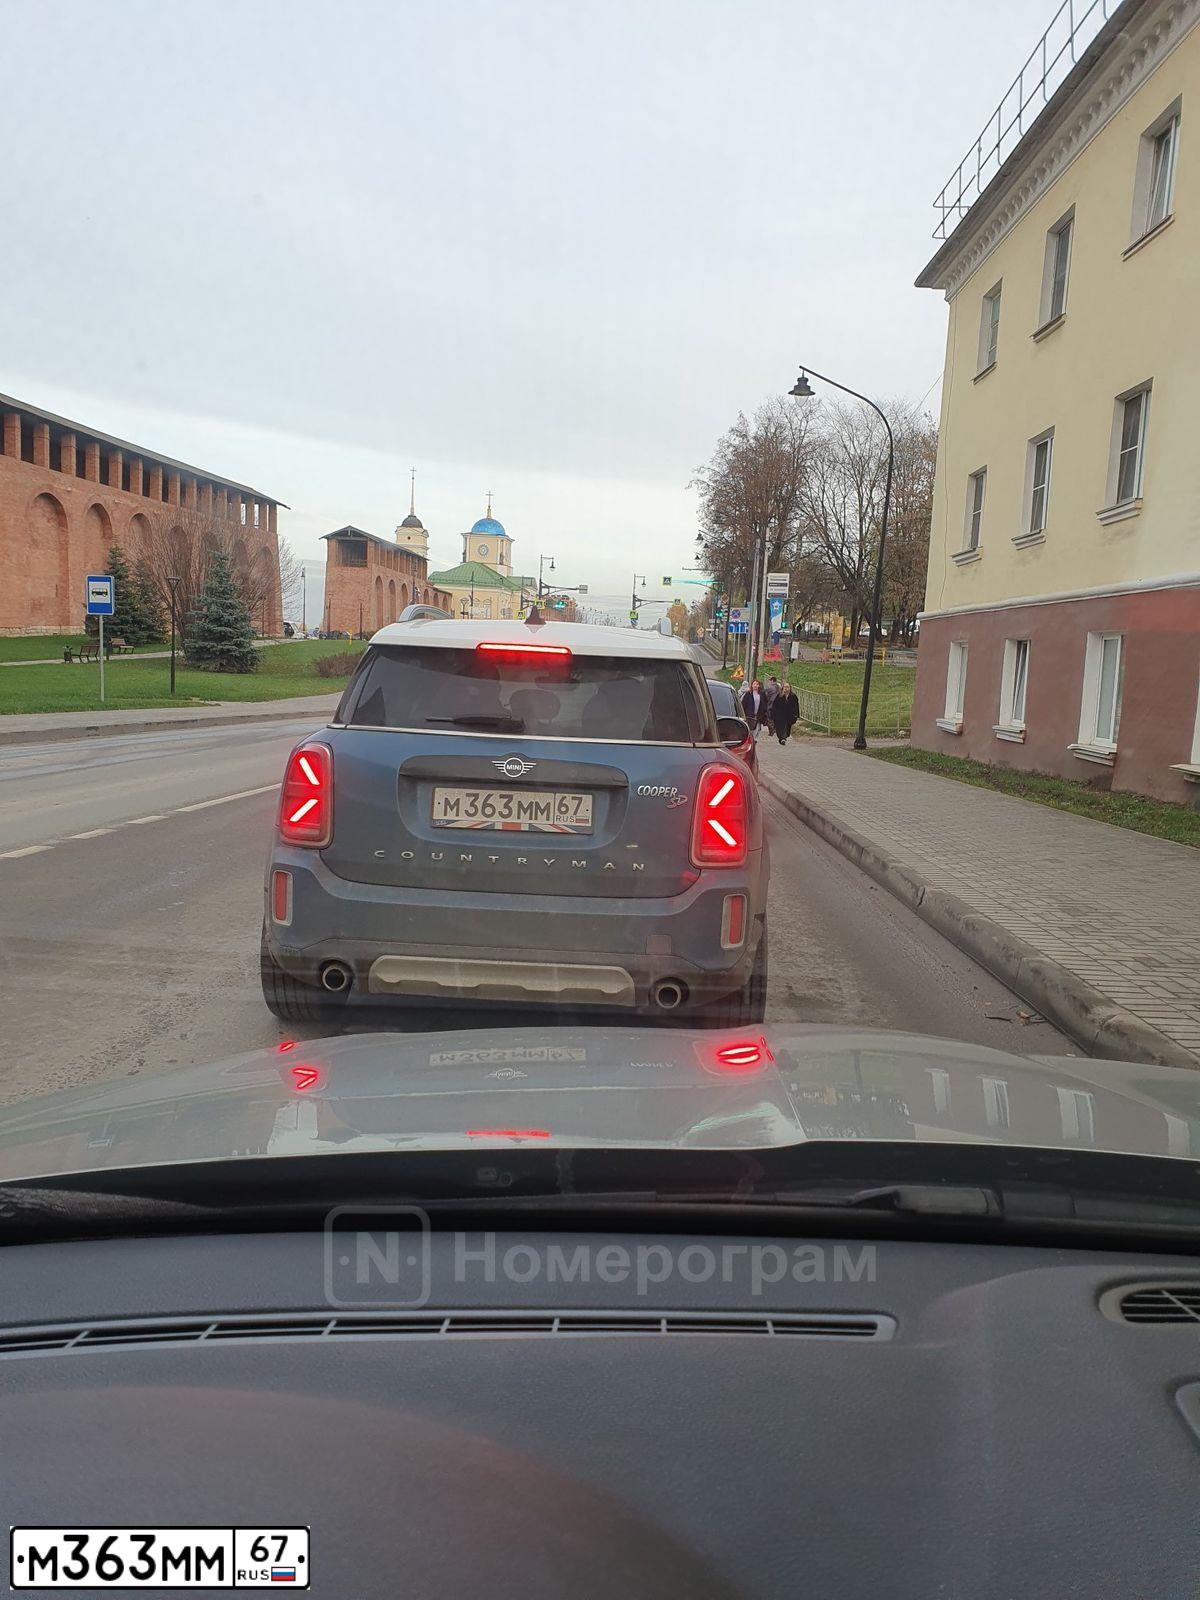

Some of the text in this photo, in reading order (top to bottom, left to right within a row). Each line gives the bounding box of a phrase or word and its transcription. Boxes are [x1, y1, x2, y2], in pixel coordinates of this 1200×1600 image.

[637, 785, 678, 797] COOPER
[557, 795, 583, 816] 67
[555, 815, 575, 823] RUS
[374, 850, 645, 872] COUNTRYMAN
